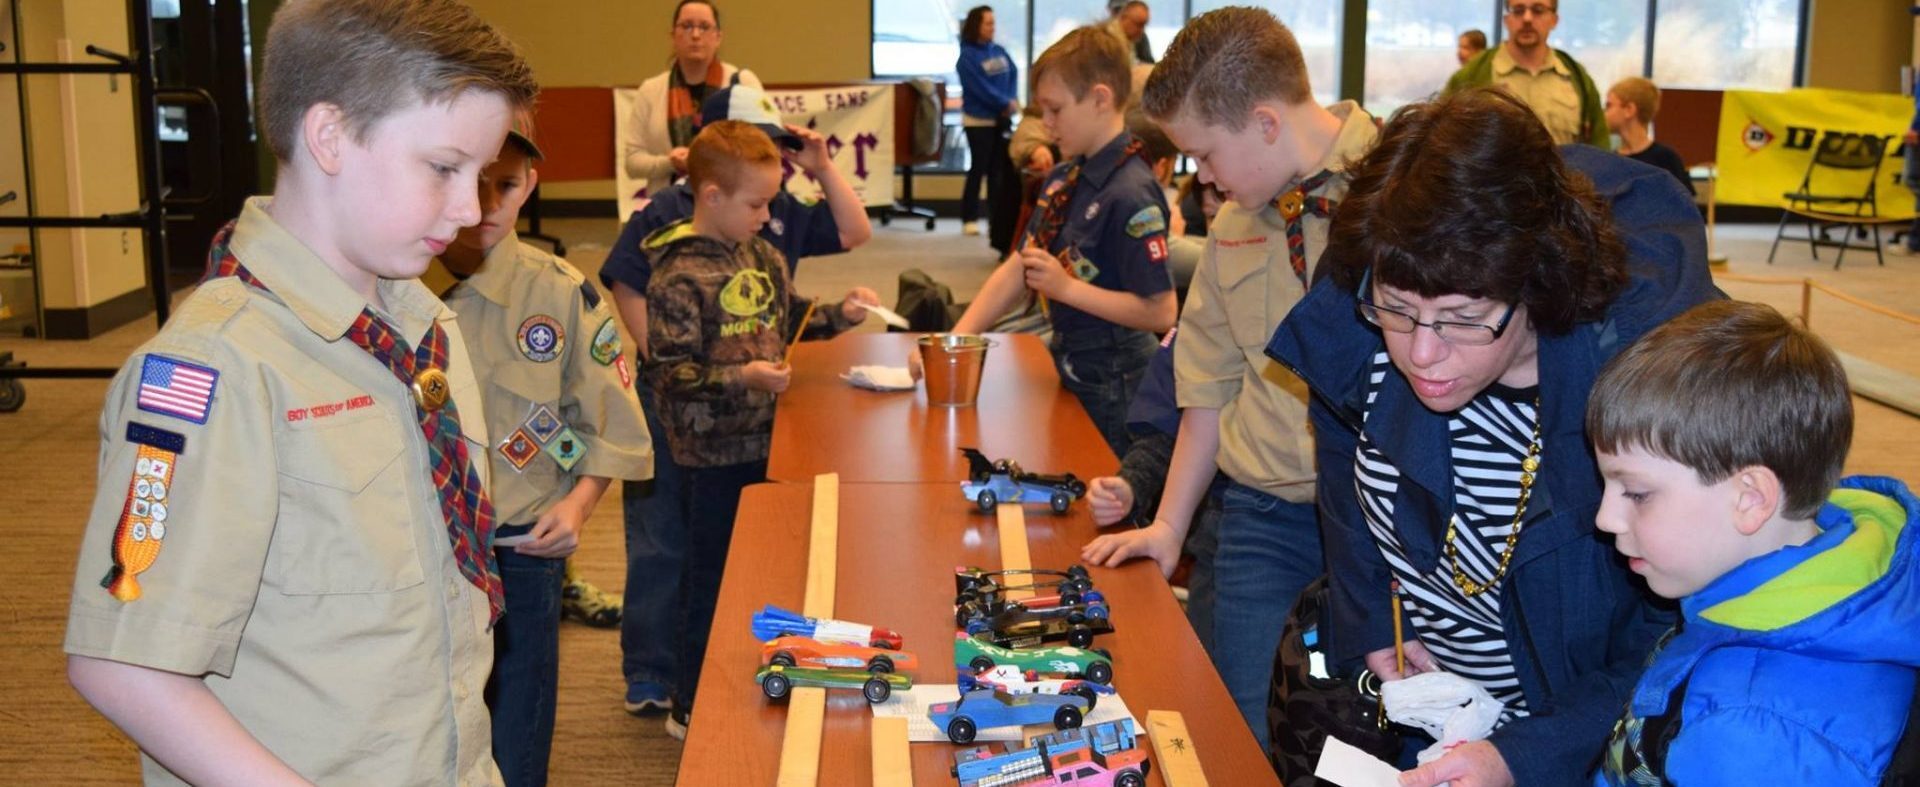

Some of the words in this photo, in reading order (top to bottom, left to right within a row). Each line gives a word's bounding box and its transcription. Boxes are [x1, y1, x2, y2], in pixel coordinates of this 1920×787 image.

[774, 96, 806, 113] ACE
[287, 408, 308, 422] BOY
[346, 394, 376, 411] AMERICA
